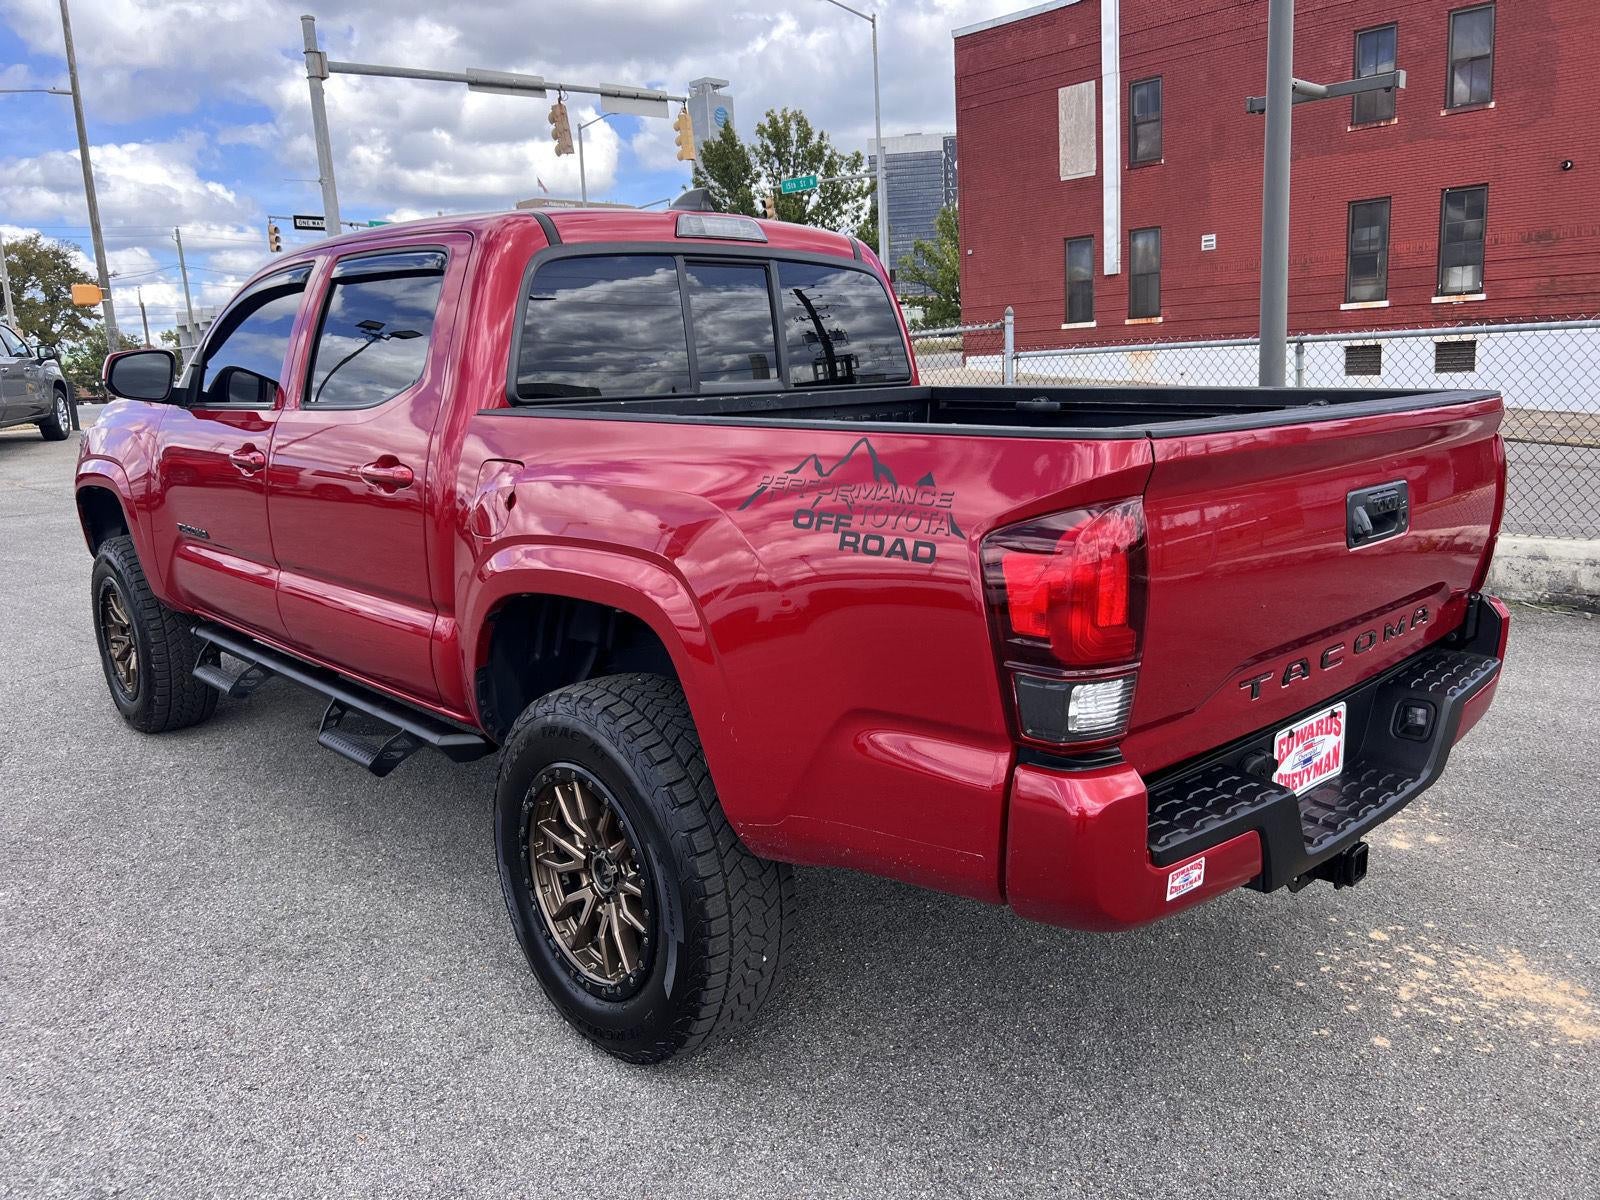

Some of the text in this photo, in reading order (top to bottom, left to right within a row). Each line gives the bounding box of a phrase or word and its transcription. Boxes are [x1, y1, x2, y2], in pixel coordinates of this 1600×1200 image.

[785, 181, 797, 190] 15th
[757, 474, 955, 509] PERFORMANCE
[792, 508, 852, 535] OFF
[855, 503, 953, 537] TOYOTA
[837, 530, 938, 565] ROAD
[1239, 604, 1431, 701] TACOMA
[1277, 709, 1342, 768] EDWARDS
[1169, 870, 1203, 896] CHEVYMAN
[1170, 862, 1203, 885] EDWARDS
